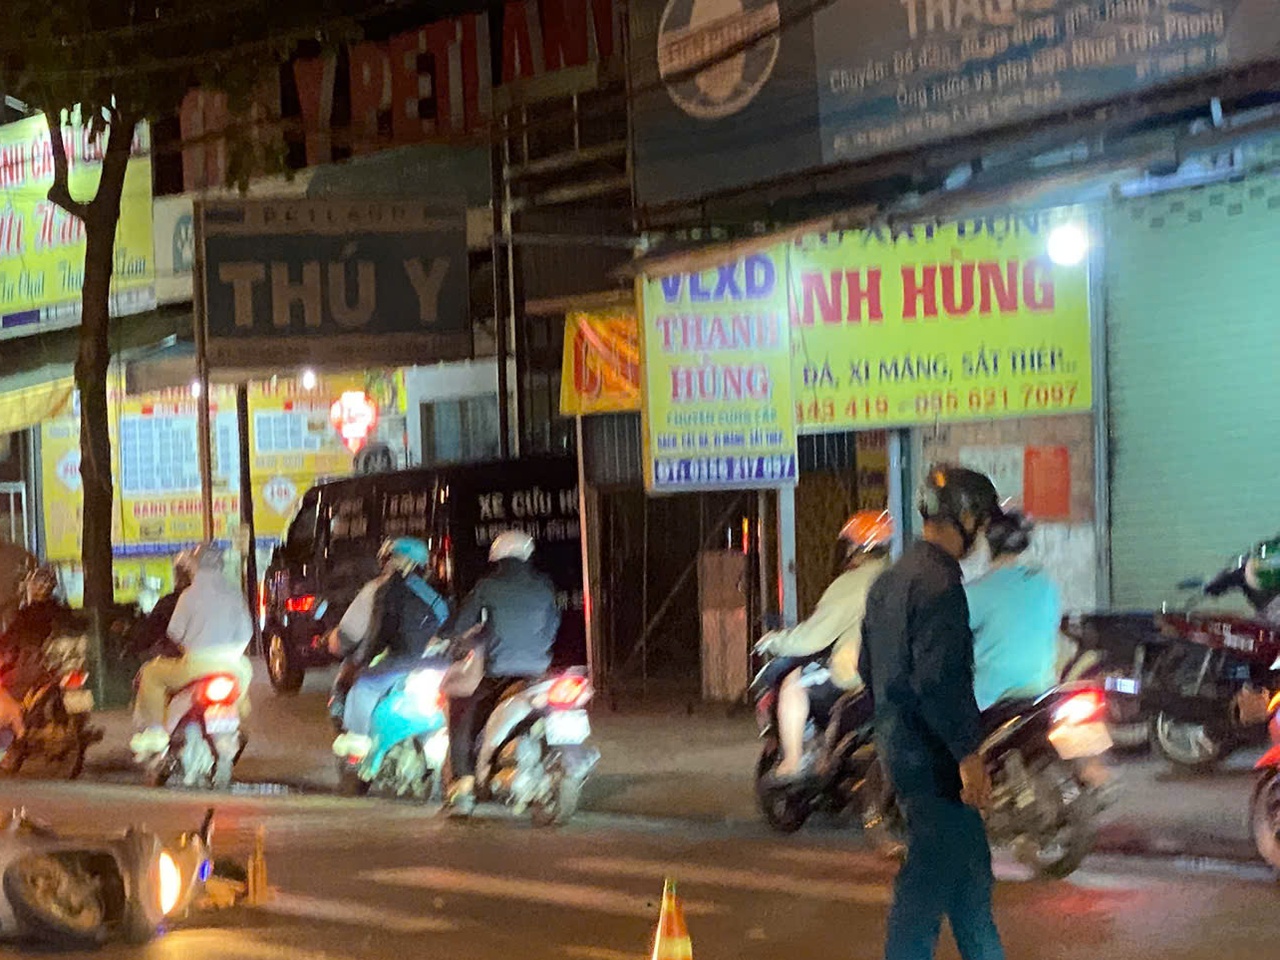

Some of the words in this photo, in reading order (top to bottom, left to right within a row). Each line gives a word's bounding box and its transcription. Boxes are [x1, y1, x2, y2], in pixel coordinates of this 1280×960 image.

[219, 241, 376, 328] THÚ
[403, 256, 451, 322] Y
[656, 312, 779, 352] THANH
[849, 358, 870, 384] XI
